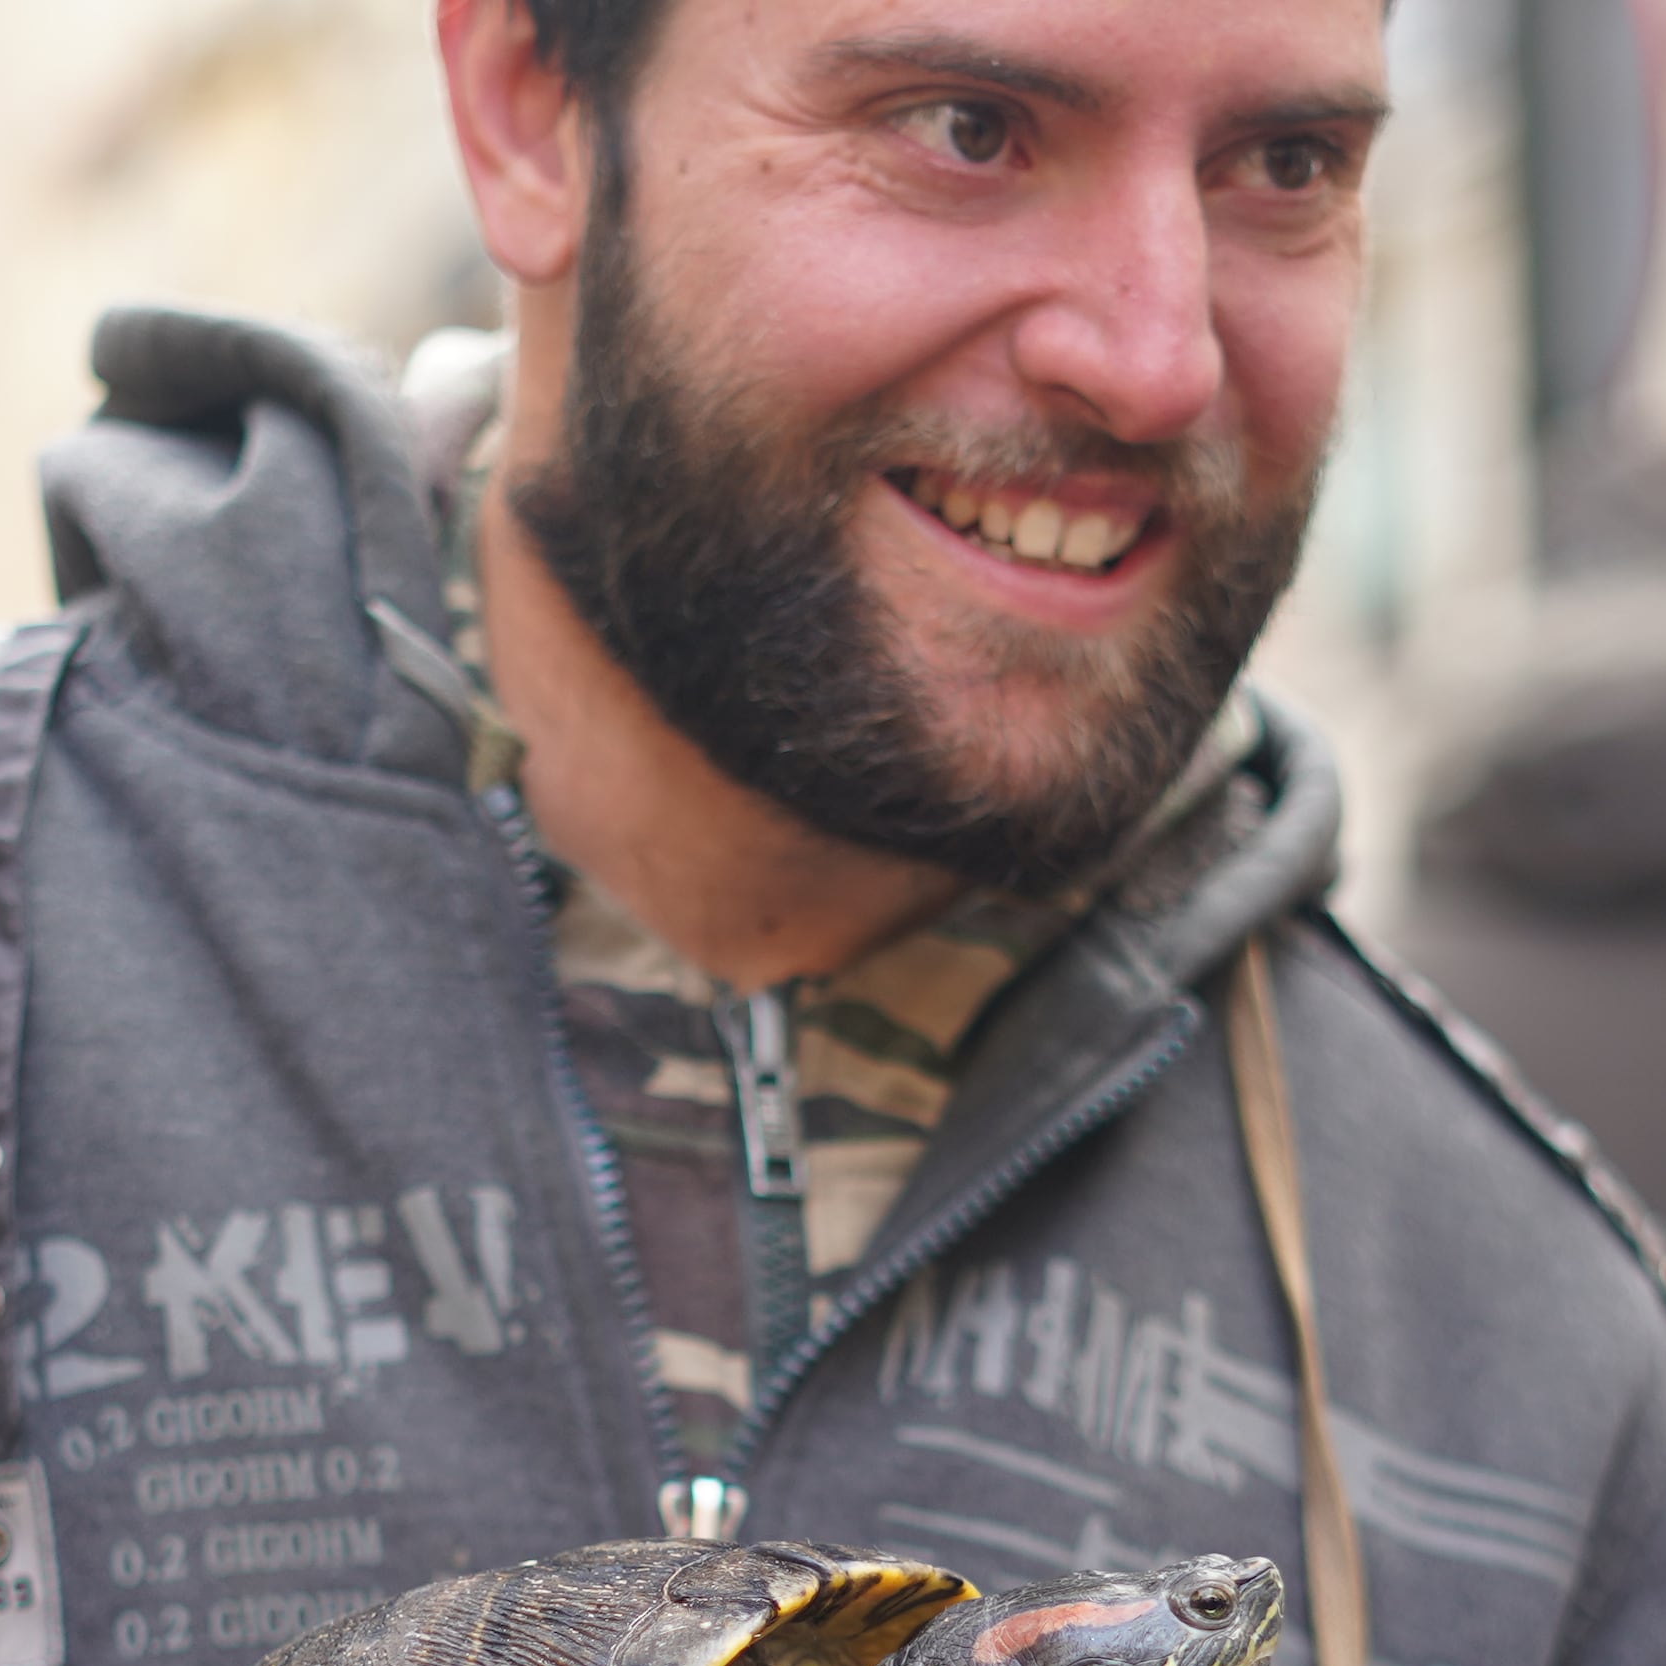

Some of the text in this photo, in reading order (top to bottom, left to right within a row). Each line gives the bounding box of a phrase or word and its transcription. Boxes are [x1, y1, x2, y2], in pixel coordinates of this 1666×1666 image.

[60, 1406, 134, 1472] 0.2
[324, 1445, 400, 1496] 0.2
[110, 1535, 188, 1587] 0.2
[114, 1604, 192, 1659] 0.2
